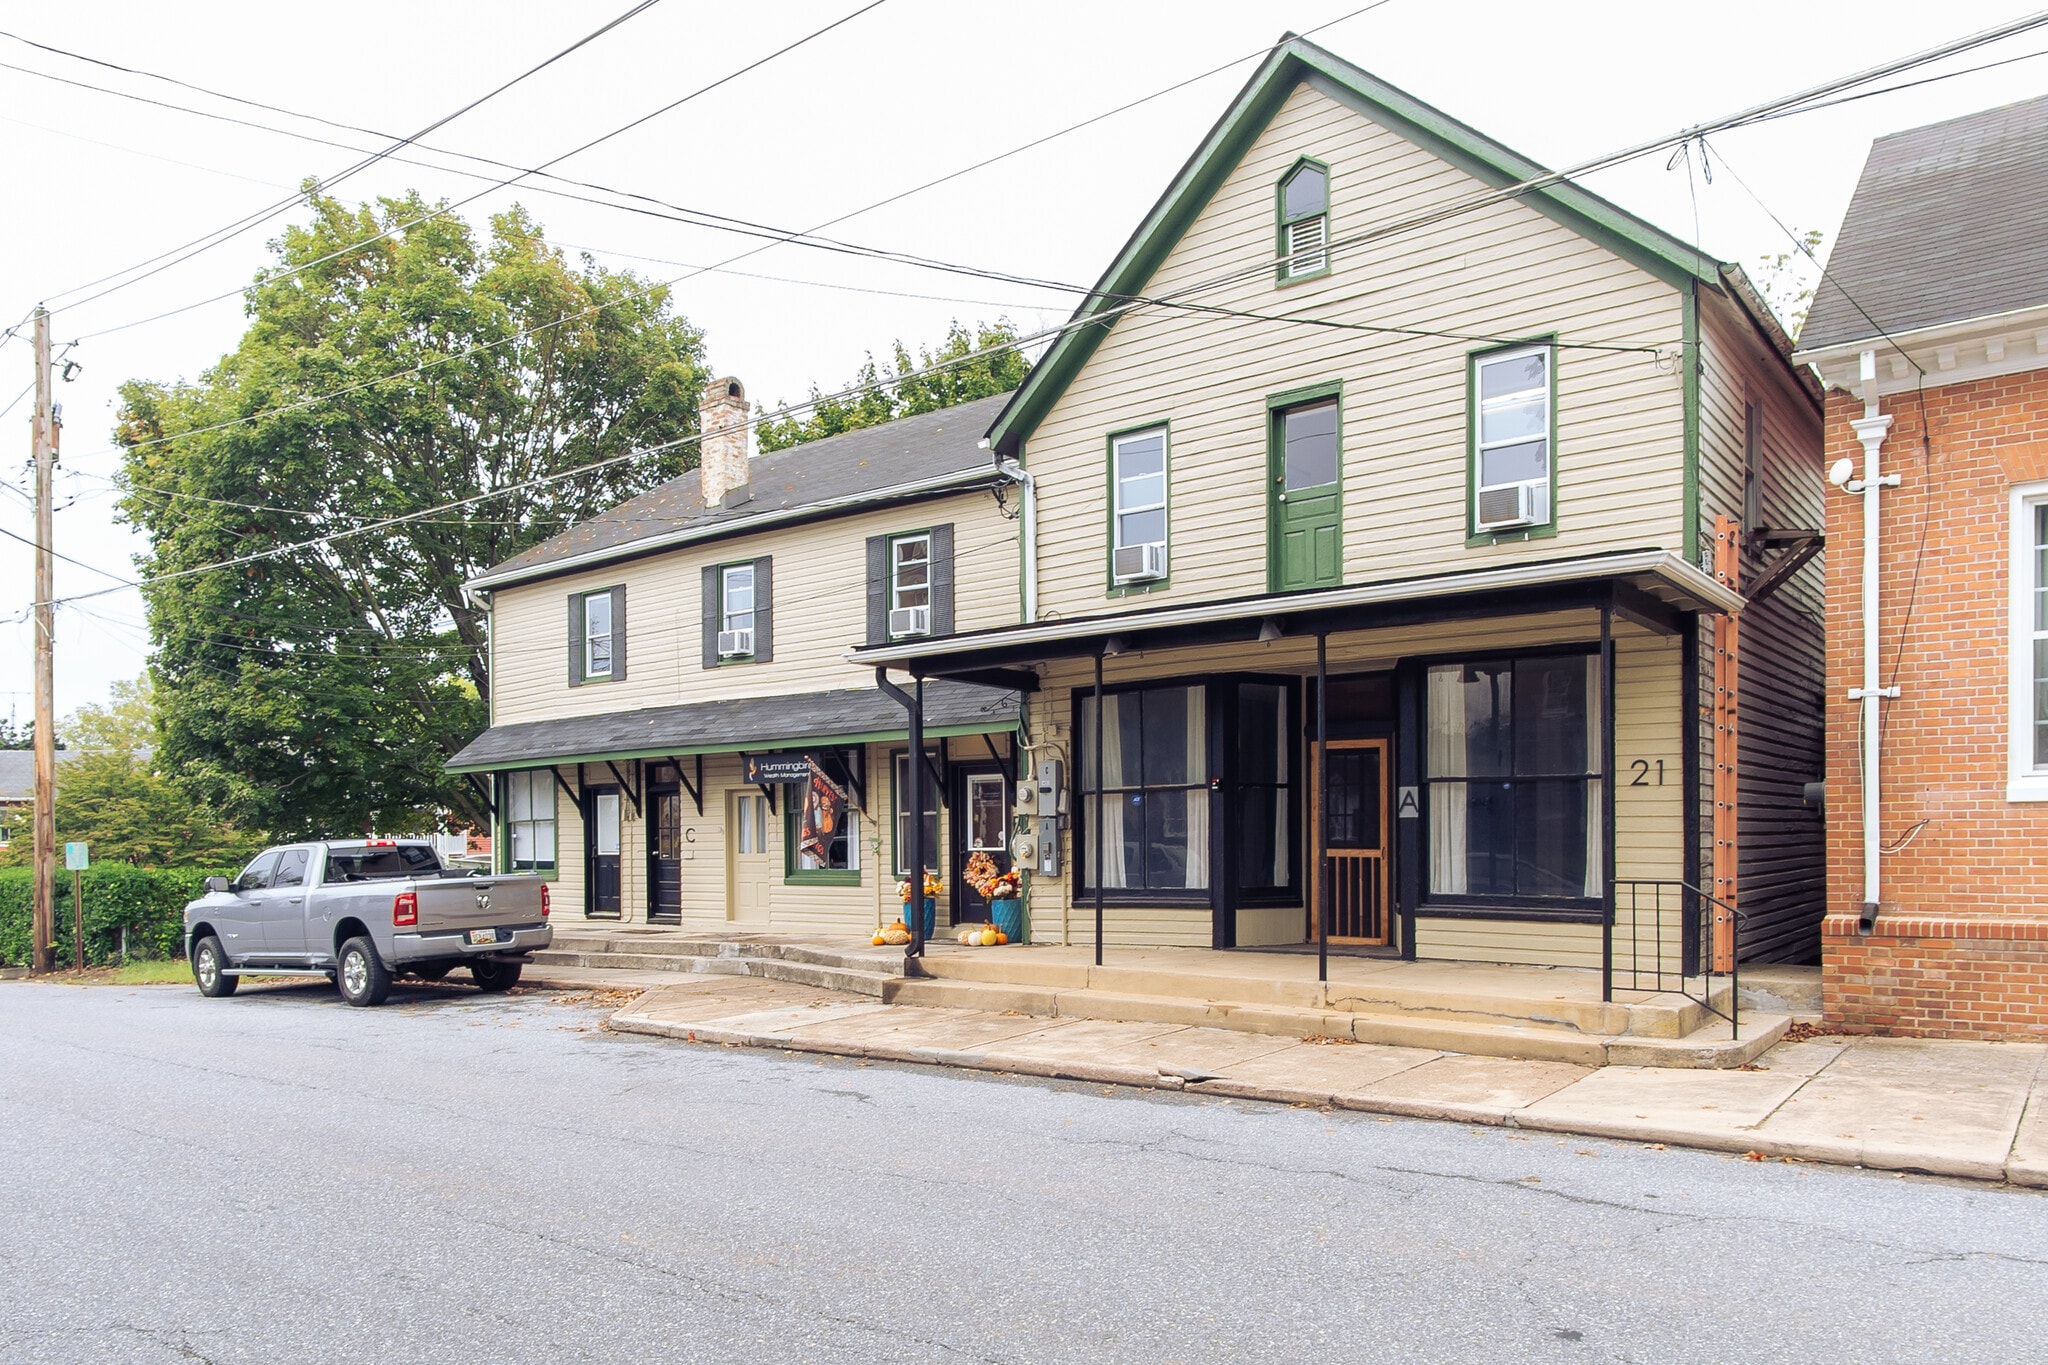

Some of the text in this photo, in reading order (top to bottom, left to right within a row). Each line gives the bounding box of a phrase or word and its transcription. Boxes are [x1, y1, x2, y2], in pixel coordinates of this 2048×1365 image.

[1630, 759, 1665, 786] 21
[1399, 790, 1419, 813] A
[686, 827, 696, 843] C
